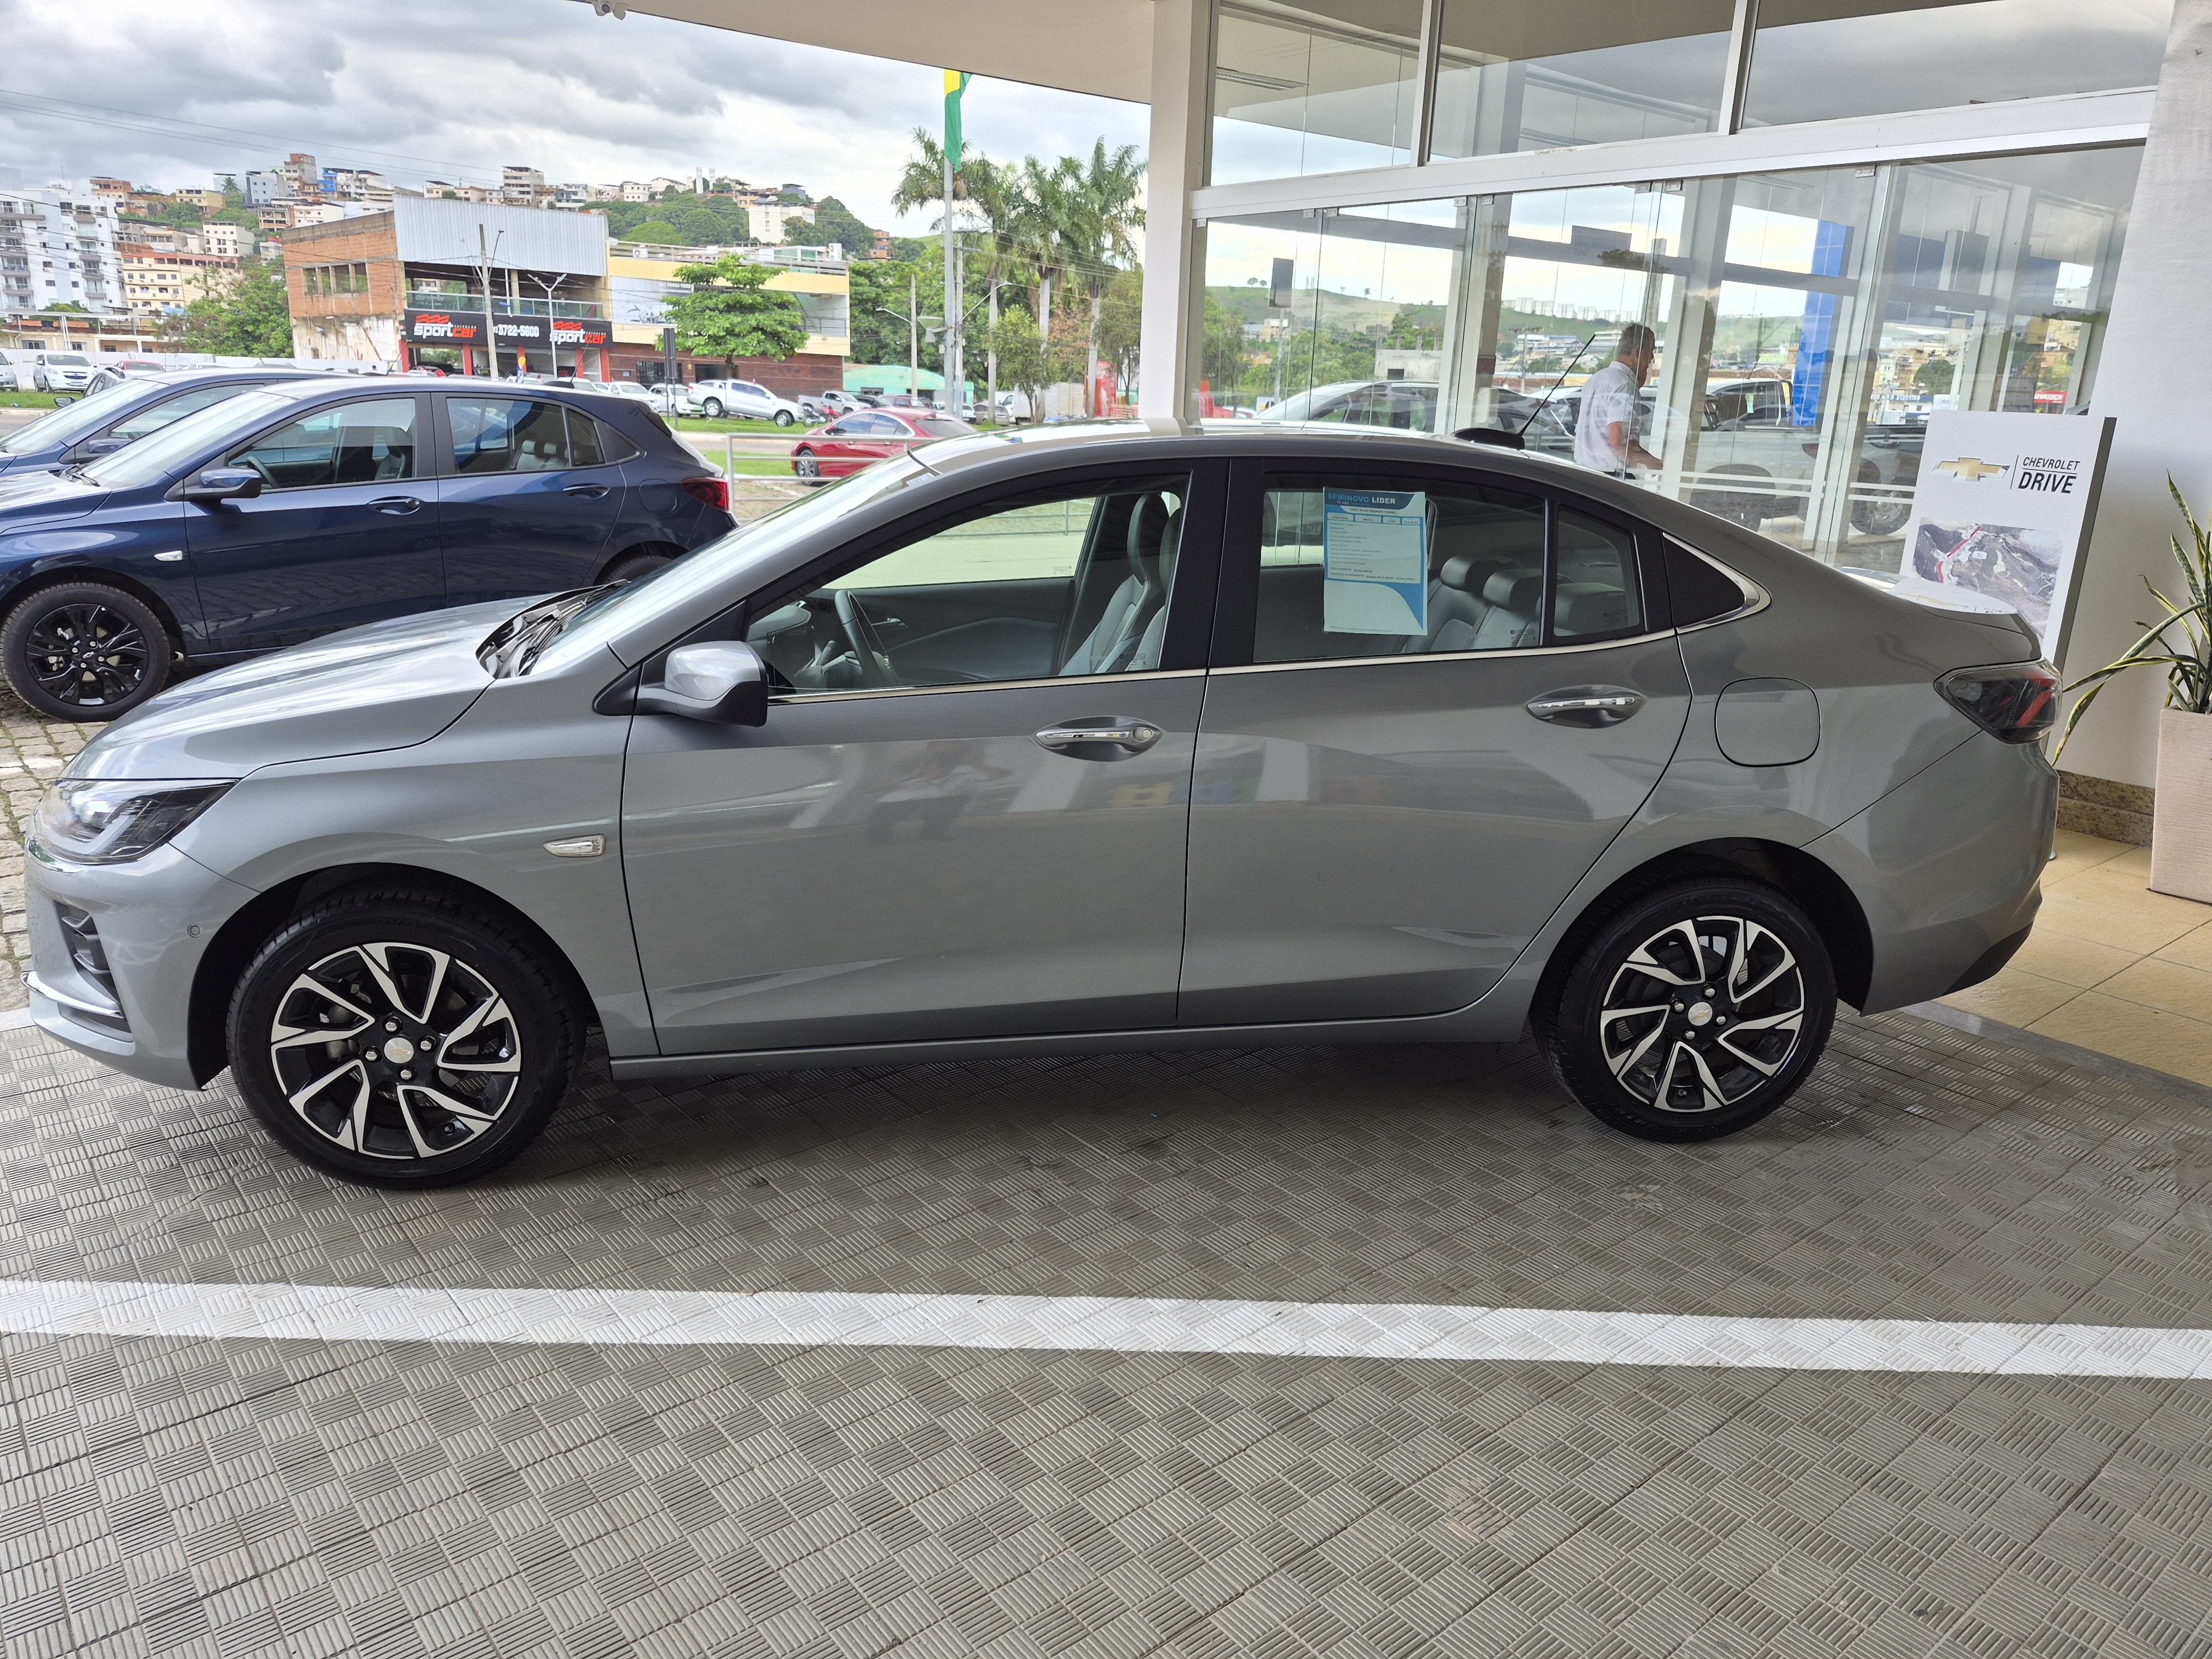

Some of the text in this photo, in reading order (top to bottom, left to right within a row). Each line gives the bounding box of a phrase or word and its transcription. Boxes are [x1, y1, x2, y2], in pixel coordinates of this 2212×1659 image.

[414, 322, 477, 339] sportcar
[2023, 457, 2080, 471] CHEVROLET
[2017, 471, 2077, 494] DRIVE
[1328, 493, 1369, 503] SEMINOVO
